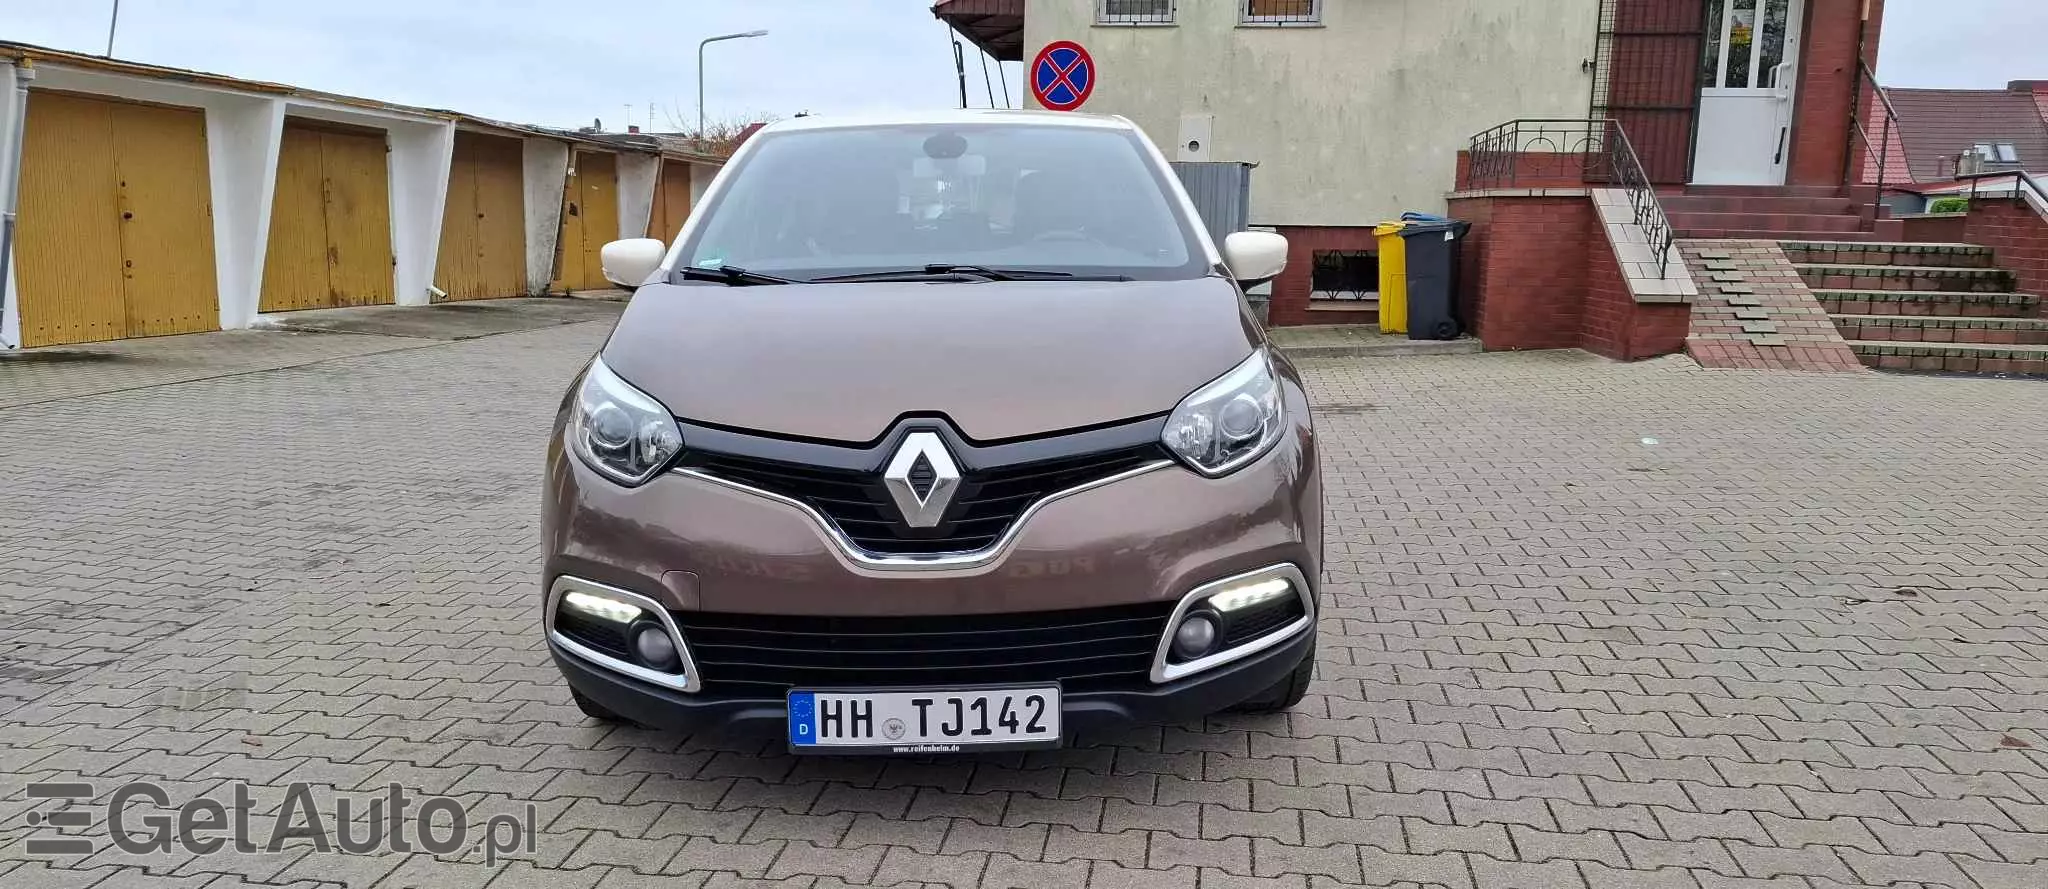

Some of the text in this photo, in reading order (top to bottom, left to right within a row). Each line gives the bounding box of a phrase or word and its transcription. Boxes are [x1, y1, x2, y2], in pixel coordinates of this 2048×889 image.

[799, 723, 809, 735] D
[820, 694, 1047, 738] HH TJ142
